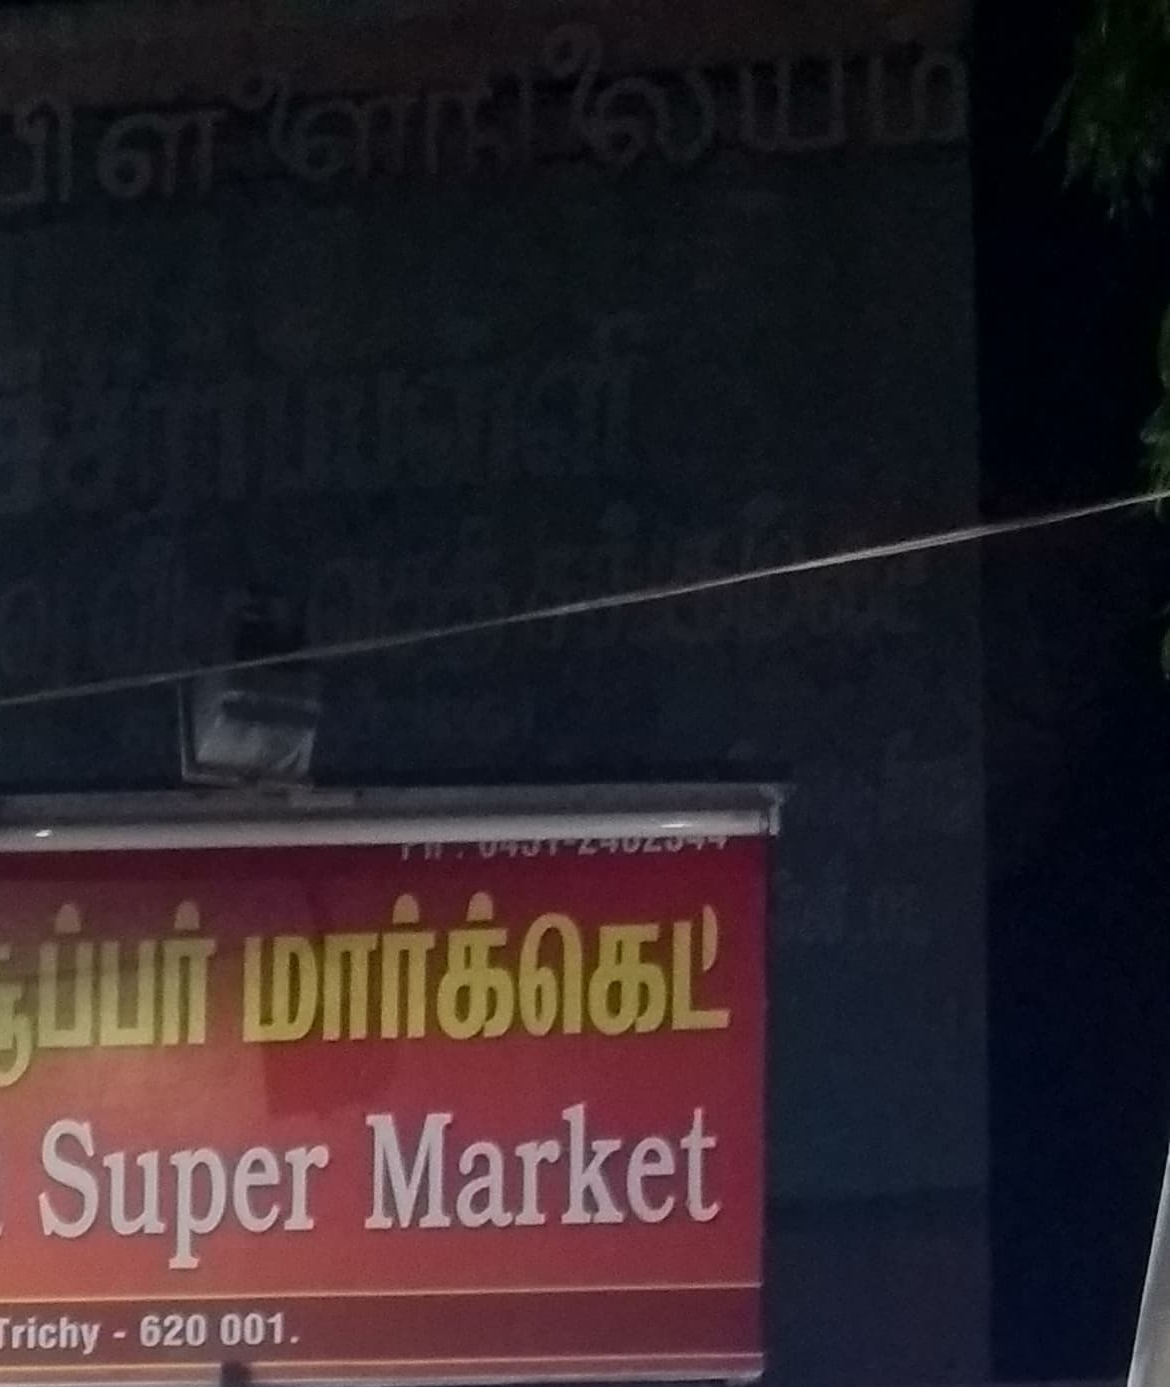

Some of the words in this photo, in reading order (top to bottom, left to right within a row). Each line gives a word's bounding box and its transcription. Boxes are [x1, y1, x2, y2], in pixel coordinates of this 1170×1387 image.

[242, 890, 729, 1045] மார்க்கெட்
[38, 1117, 330, 1270] Super
[365, 1104, 720, 1232] Market
[139, 1313, 208, 1348] 620
[220, 1312, 301, 1347] 001.
